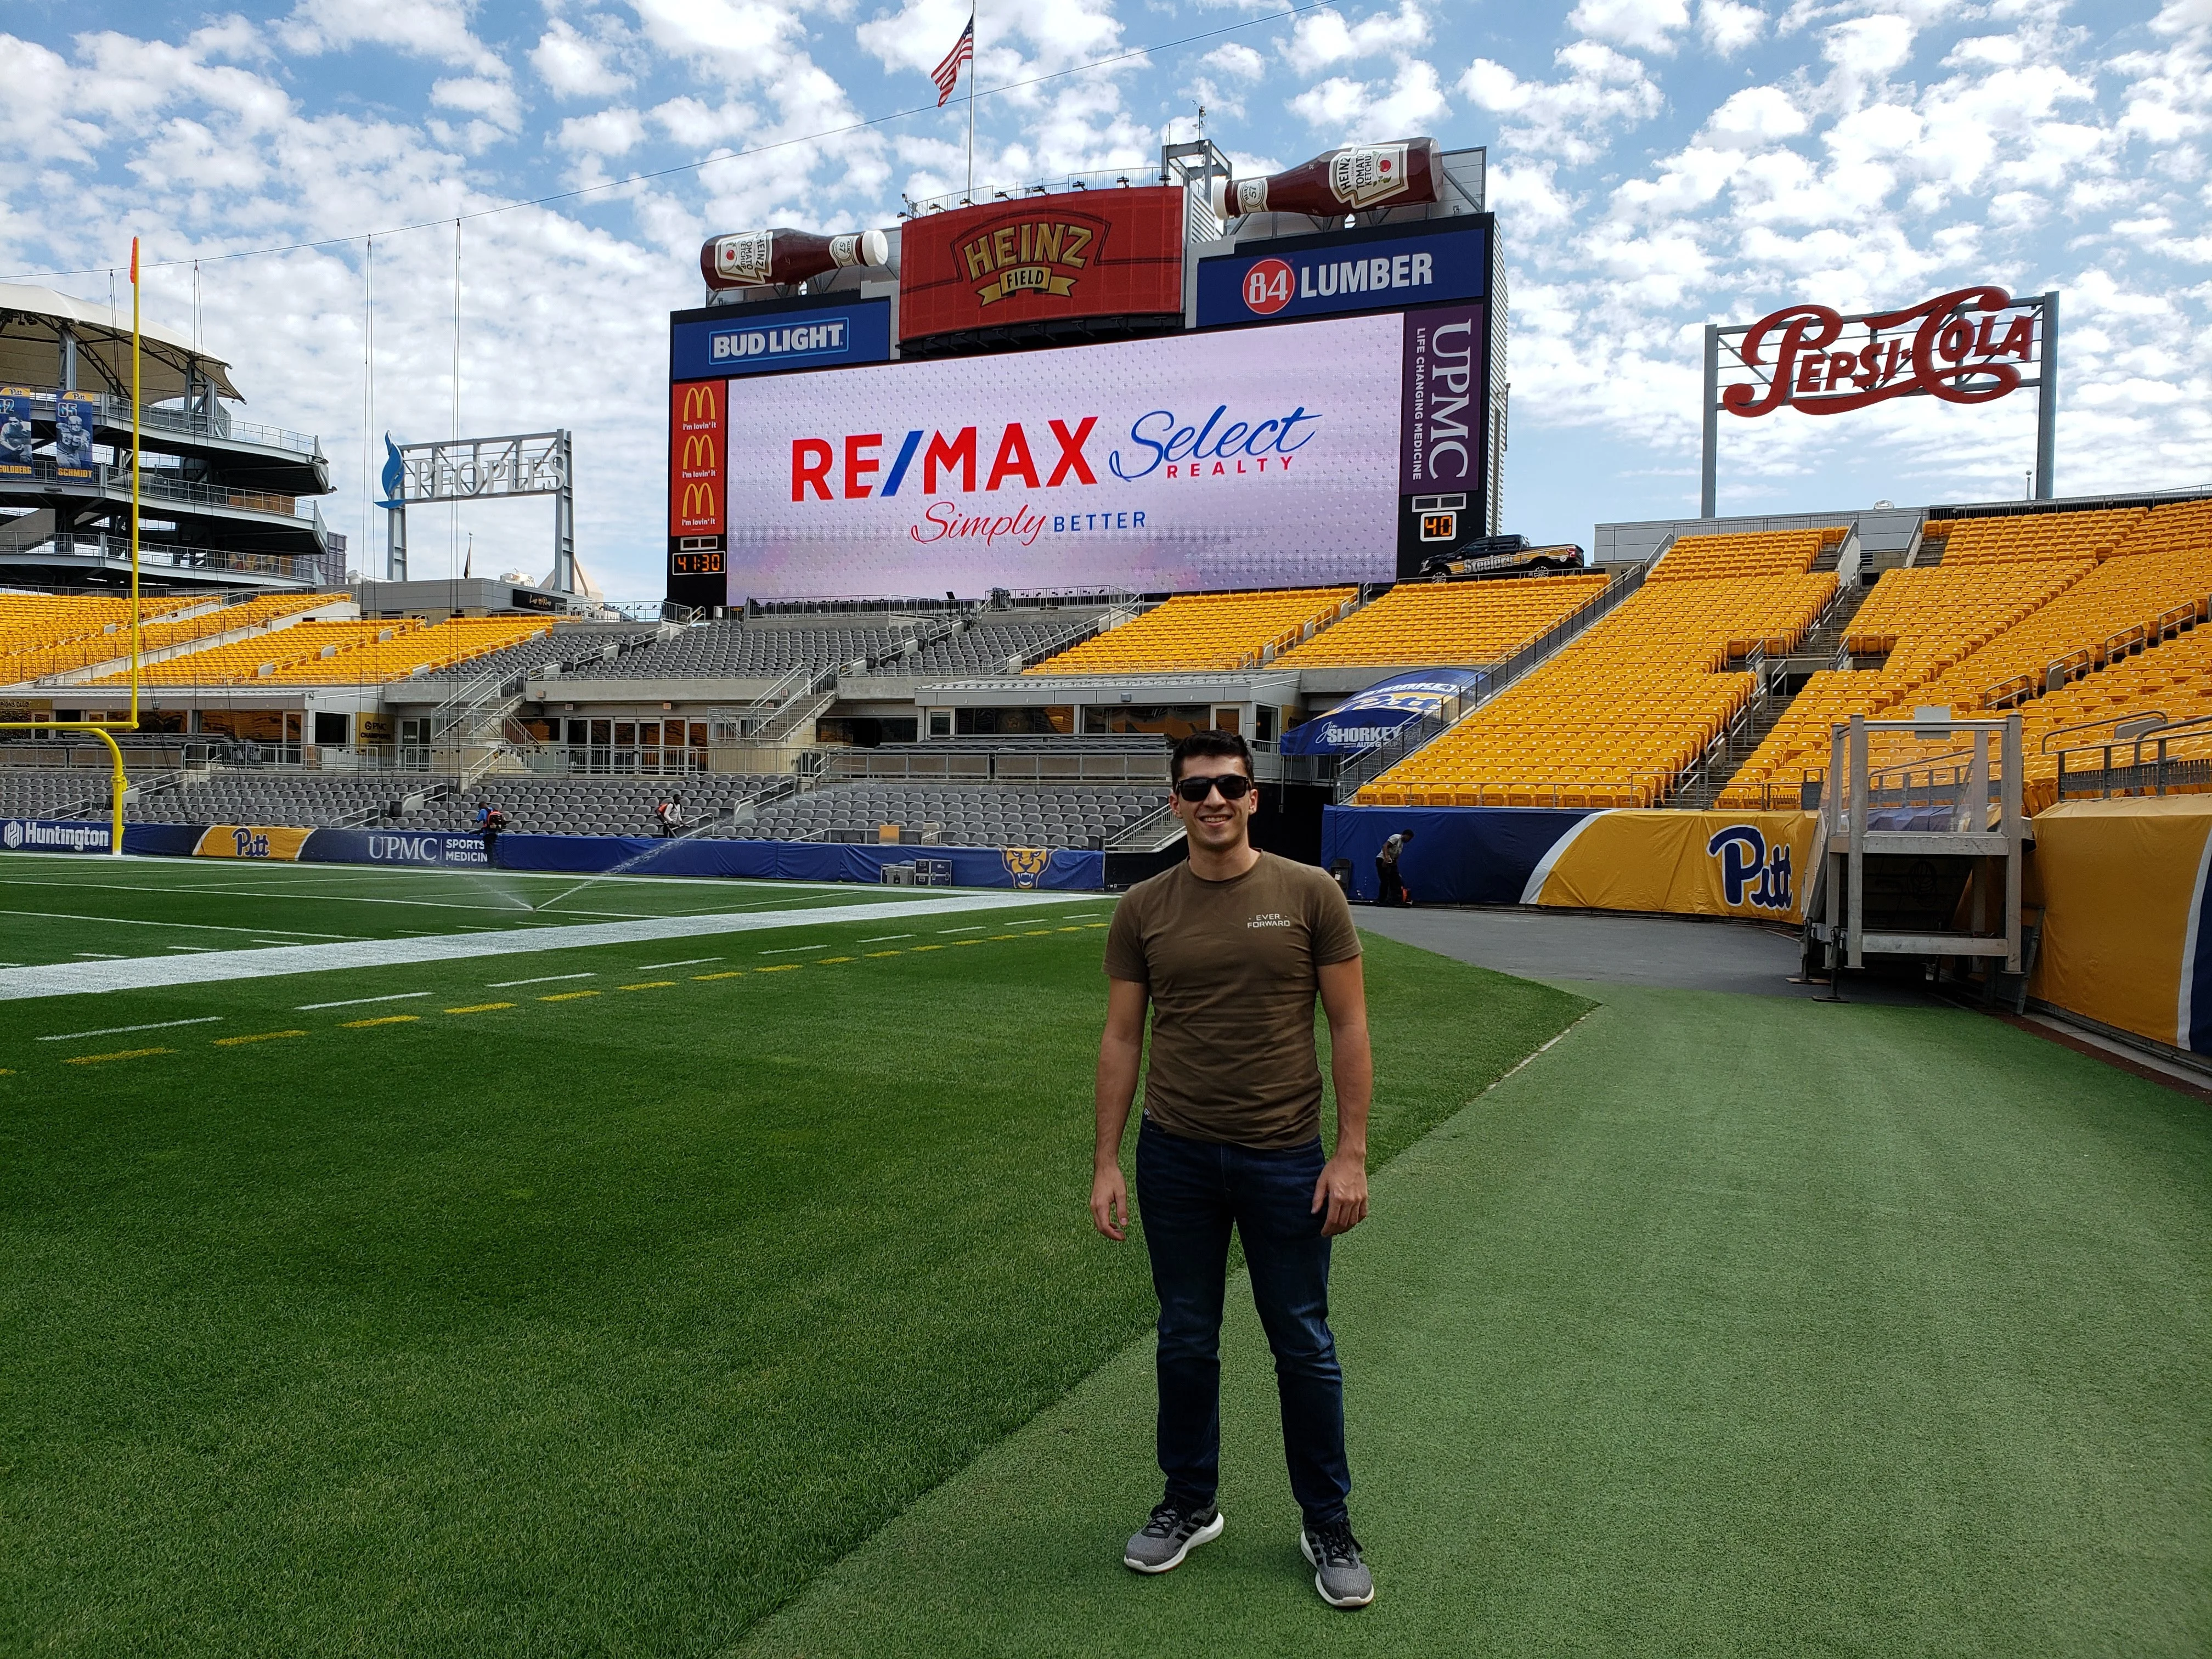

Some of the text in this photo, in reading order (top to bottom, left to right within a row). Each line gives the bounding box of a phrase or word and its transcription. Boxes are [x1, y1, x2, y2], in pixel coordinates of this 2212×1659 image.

[1339, 157, 1351, 191] HEINZ
[1356, 154, 1365, 190] TOMATO
[1249, 187, 1256, 199] 57
[755, 238, 765, 267] HEINZ
[839, 242, 845, 253] 57
[963, 223, 1093, 282] HEINZ
[1006, 269, 1045, 289] FIELD
[1248, 252, 1432, 304] 84 LUMBER
[713, 324, 843, 359] BUD LIGHT
[58, 402, 77, 417] 65
[1413, 328, 1425, 480] LIFE CHANGING MEDICINE
[1429, 318, 1471, 480] UPMC
[62, 436, 81, 447] 65
[792, 405, 1323, 502] RE/MAX Select
[58, 468, 93, 478] SCHMIDT
[411, 454, 566, 499] PEOPLES
[693, 470, 710, 478] lovin'
[1166, 456, 1294, 479] REALTY
[692, 518, 710, 526] lovin'
[911, 501, 1146, 546] Simply BETTER
[1425, 516, 1452, 536] 40
[1463, 555, 1513, 574] Steelers
[373, 722, 386, 730] PNC
[1316, 721, 1338, 744] Jim
[1327, 726, 1402, 743] SHORKEY
[25, 822, 109, 851] Huntington
[232, 827, 270, 858] Pitt
[369, 837, 484, 860] UPMC SPORTS
[446, 851, 488, 862] MEDICIN
[1706, 824, 1793, 911] Pitt
[1247, 920, 1290, 928] FORWARD
